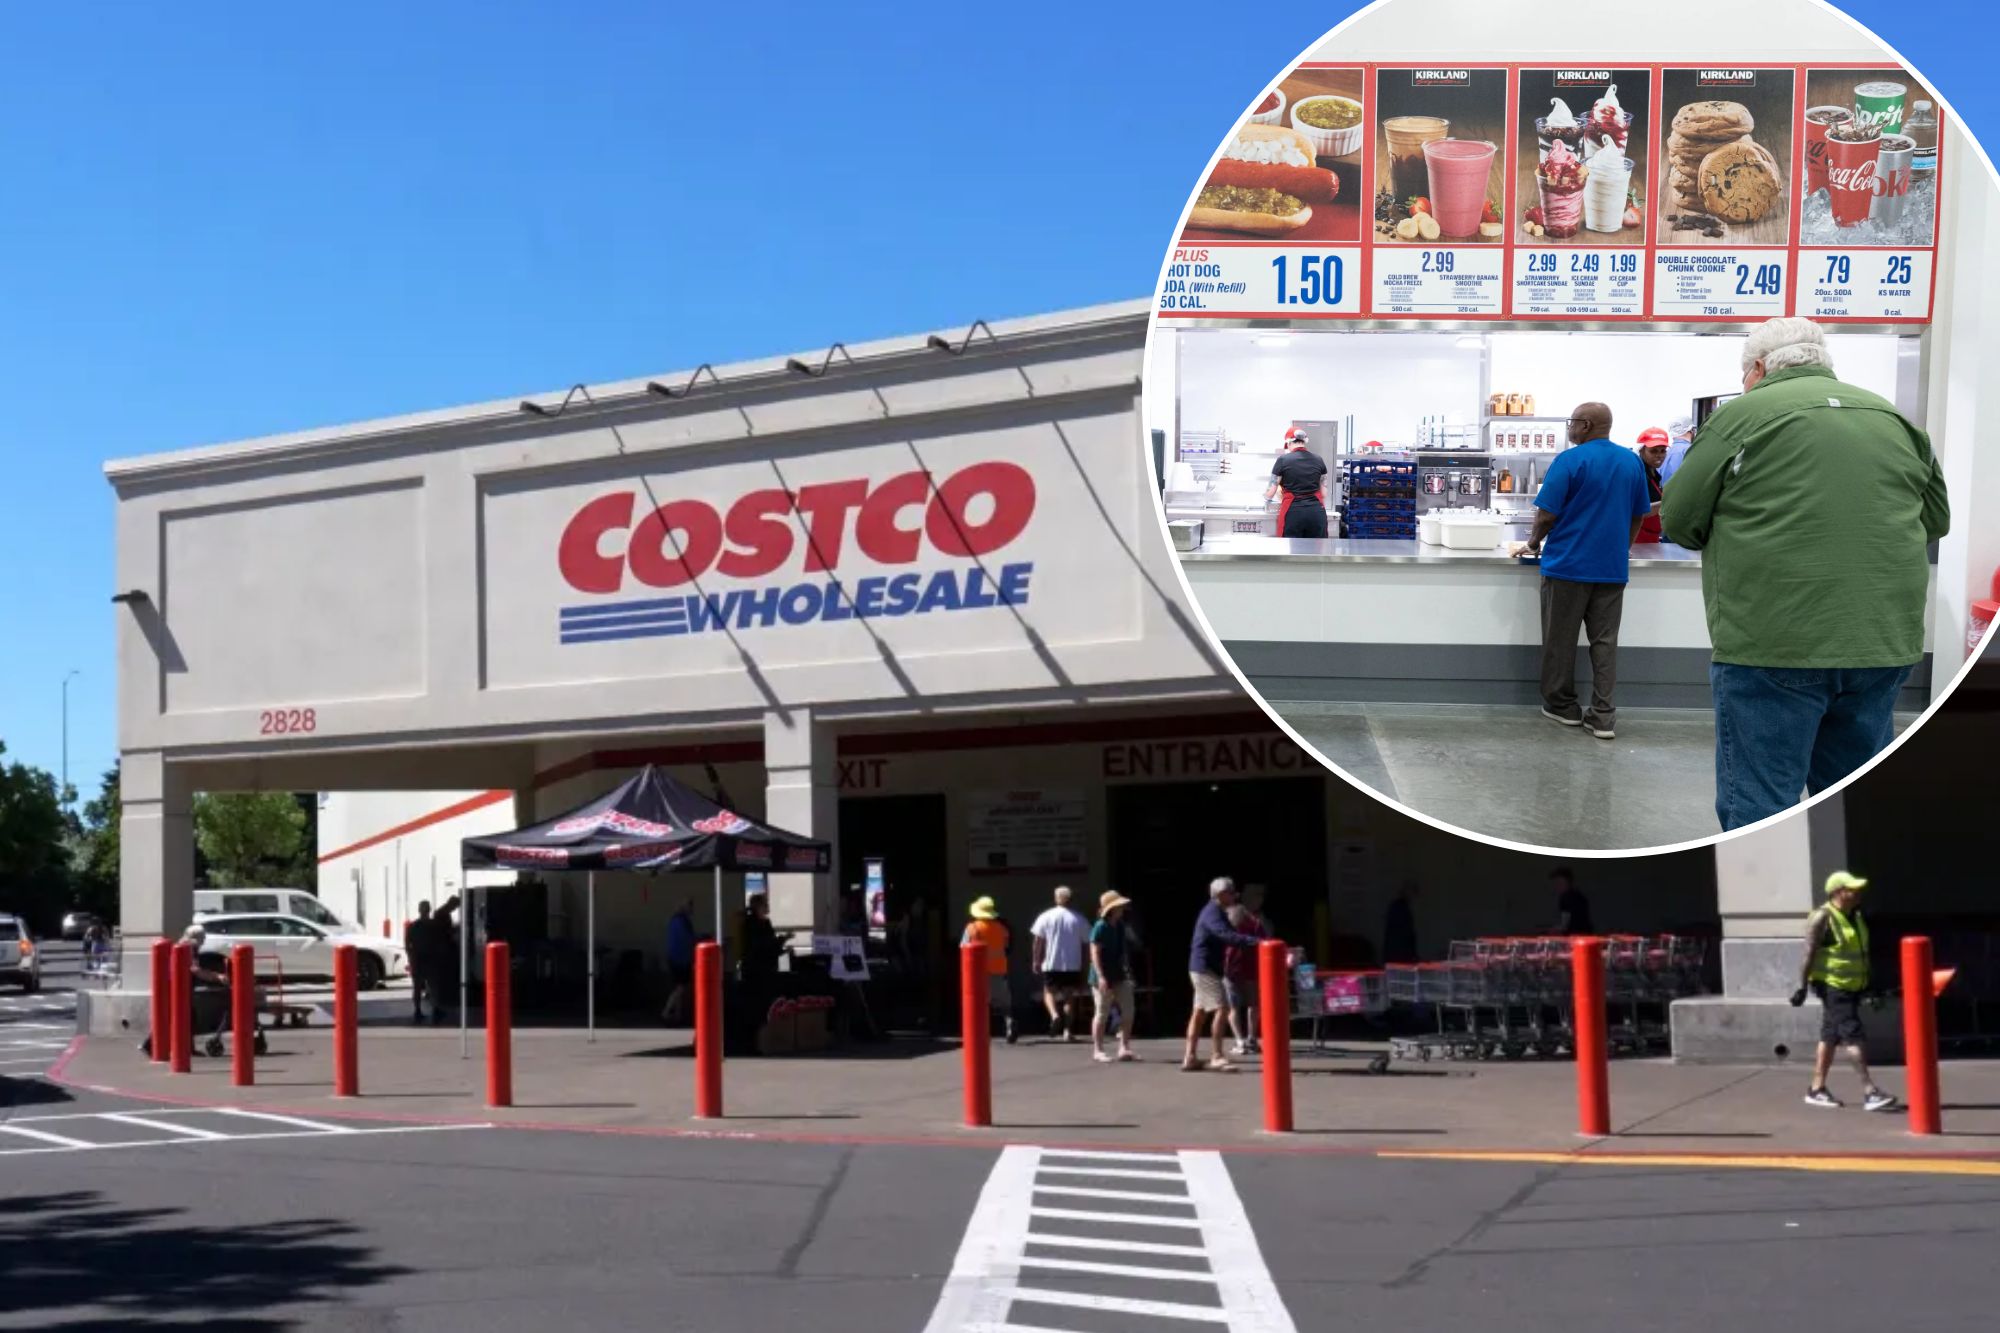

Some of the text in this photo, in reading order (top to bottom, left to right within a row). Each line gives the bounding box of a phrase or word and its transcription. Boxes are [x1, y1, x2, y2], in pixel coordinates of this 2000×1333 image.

[1415, 70, 1468, 79] KIRKLAND
[1557, 71, 1610, 80] KIRKLAND
[1700, 70, 1754, 80] KIRKLAND
[1173, 249, 1209, 262] PLUS
[1422, 251, 1454, 272] 2.99
[1528, 253, 1557, 272] 2.99
[1571, 254, 1599, 273] 2.49
[1610, 254, 1637, 273] 1.99
[1657, 256, 1737, 264] DOUBLE CHOCOLATE
[1168, 264, 1221, 277] HOT DOG
[1667, 264, 1726, 272] CHUNK COOKIE
[1819, 255, 1851, 284] .79
[1880, 255, 1912, 284] .25
[1272, 255, 1343, 305] 1.50
[1736, 264, 1781, 295] 2.49
[1189, 282, 1215, 294] (With
[1217, 282, 1246, 294] Refill)
[1180, 295, 1207, 309] CAL.
[1703, 306, 1735, 315] 750 cal.
[1816, 308, 1849, 316] 0-420 cal.
[558, 461, 1036, 594] COSTCO
[685, 561, 1033, 634] WHOLESALE
[260, 708, 316, 735] 2828
